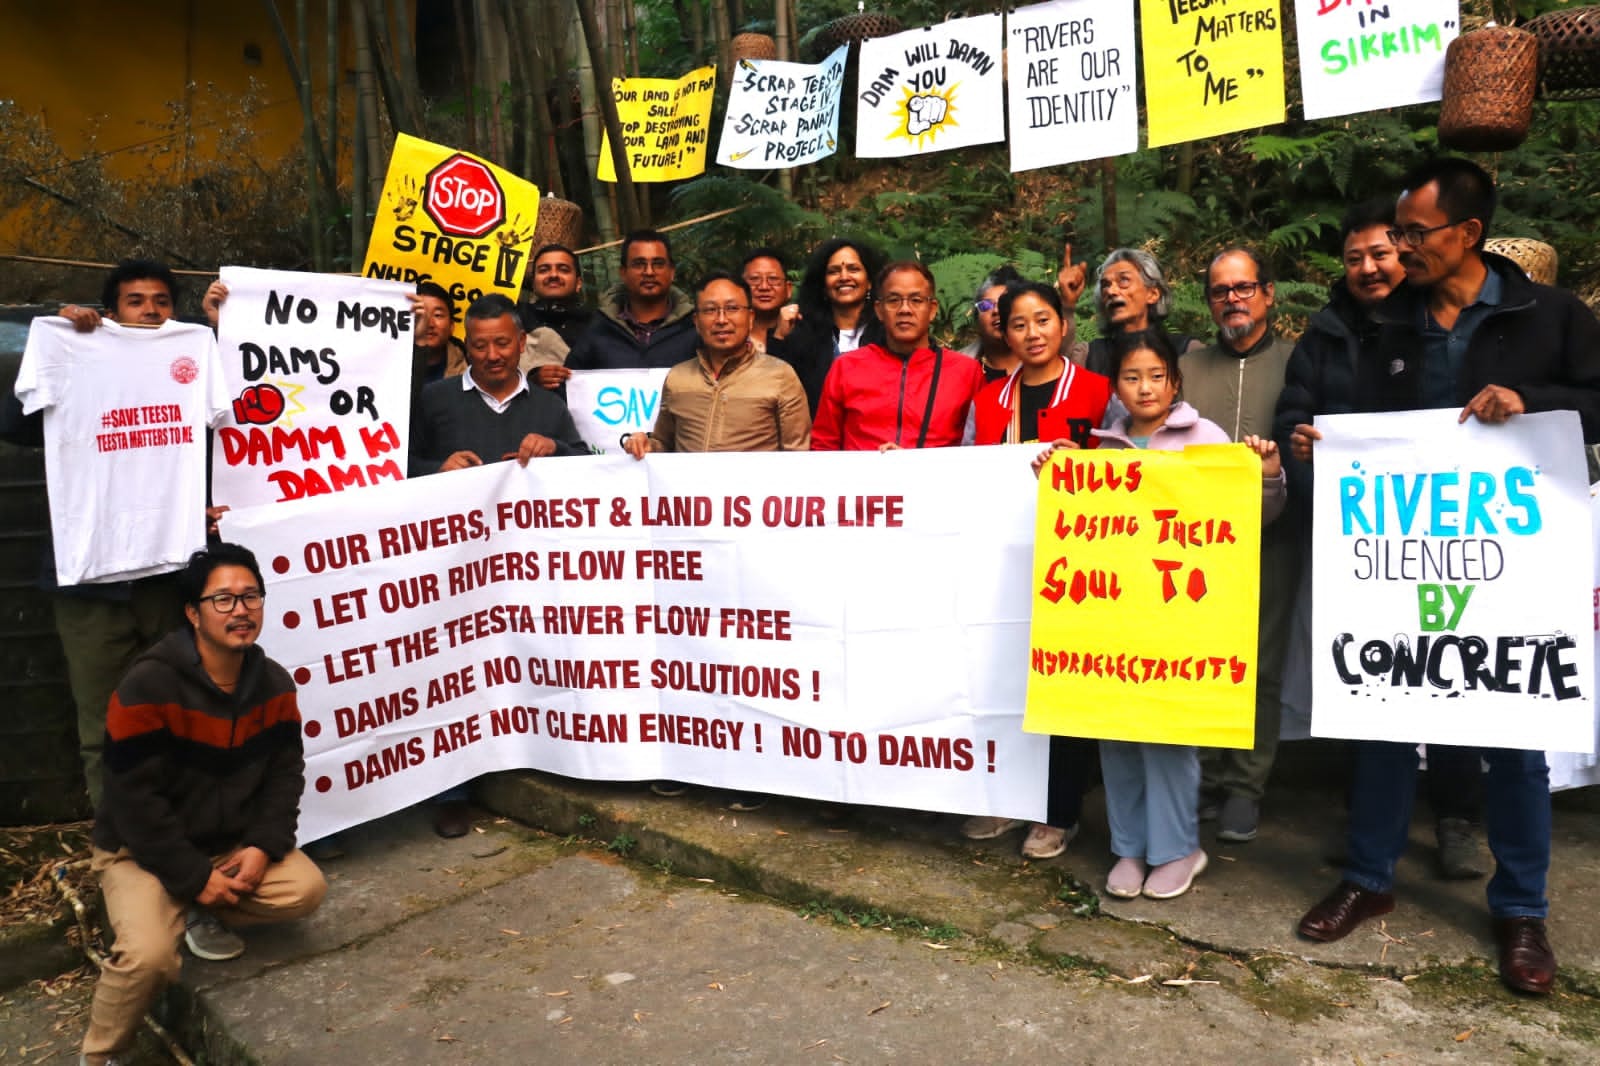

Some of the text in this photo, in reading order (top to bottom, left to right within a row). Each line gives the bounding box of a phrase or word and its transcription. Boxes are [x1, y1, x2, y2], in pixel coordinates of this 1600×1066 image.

[1169, 0, 1226, 24] TEES
[1194, 8, 1276, 46] MATTERS
[1358, 5, 1390, 28] IN
[803, 61, 842, 94] TEESTA
[860, 39, 994, 108] DAM WILL DAMN
[907, 66, 946, 93] YOU
[1027, 48, 1120, 88] ARE OUR
[1176, 49, 1209, 77] TO
[643, 90, 669, 102] LAND
[682, 81, 696, 96] NOT
[698, 77, 713, 92] FOR
[765, 95, 816, 115] STAGE
[621, 114, 700, 134] TOP DESTROYING
[656, 134, 680, 149] LAND
[685, 128, 706, 144] AND
[796, 104, 834, 137] PANAM
[434, 177, 495, 216] STOP
[393, 225, 524, 288] STAGE IV
[264, 289, 318, 326] NO
[336, 299, 411, 340] MORE
[239, 342, 340, 385] DAMS
[101, 404, 182, 428] #SAVE TEESTA
[329, 386, 379, 422] OR
[593, 386, 658, 427] SAV
[96, 426, 194, 453] TEESTA MATTERS TO ME
[219, 421, 401, 467] DAMM KI
[267, 459, 404, 502] DAMM
[1051, 456, 1142, 495] HILLS
[1340, 466, 1543, 537] RIVERS
[304, 495, 904, 574] OUR RIVERS, FOREST & LAND IS OUR LIFE
[1054, 509, 1237, 549] LOSING THEIR
[1354, 538, 1505, 581] SILENCED
[313, 549, 704, 629] LET OUR RIVERS FLOW FREE
[1040, 556, 1208, 605] SOUL TO
[1417, 583, 1476, 631] BY
[324, 605, 793, 684] LET THE TEESTA RIVER FLOW FREE
[1031, 647, 1247, 685] HYDROELECTRICITY
[1332, 633, 1582, 700] CONCRETE
[334, 687, 419, 739] DAMS
[426, 665, 477, 709] ARE
[483, 655, 522, 688] NO
[528, 656, 640, 689] CLIMATE
[651, 658, 801, 701] SOLUTIONS
[344, 737, 425, 791] DAMS
[433, 714, 482, 759] ARE
[490, 705, 540, 737] NOT
[546, 709, 628, 743] CLEAN
[639, 713, 745, 751] ENERGY
[782, 725, 822, 760] NO
[828, 730, 867, 764] TO
[878, 734, 974, 772] DAMS
